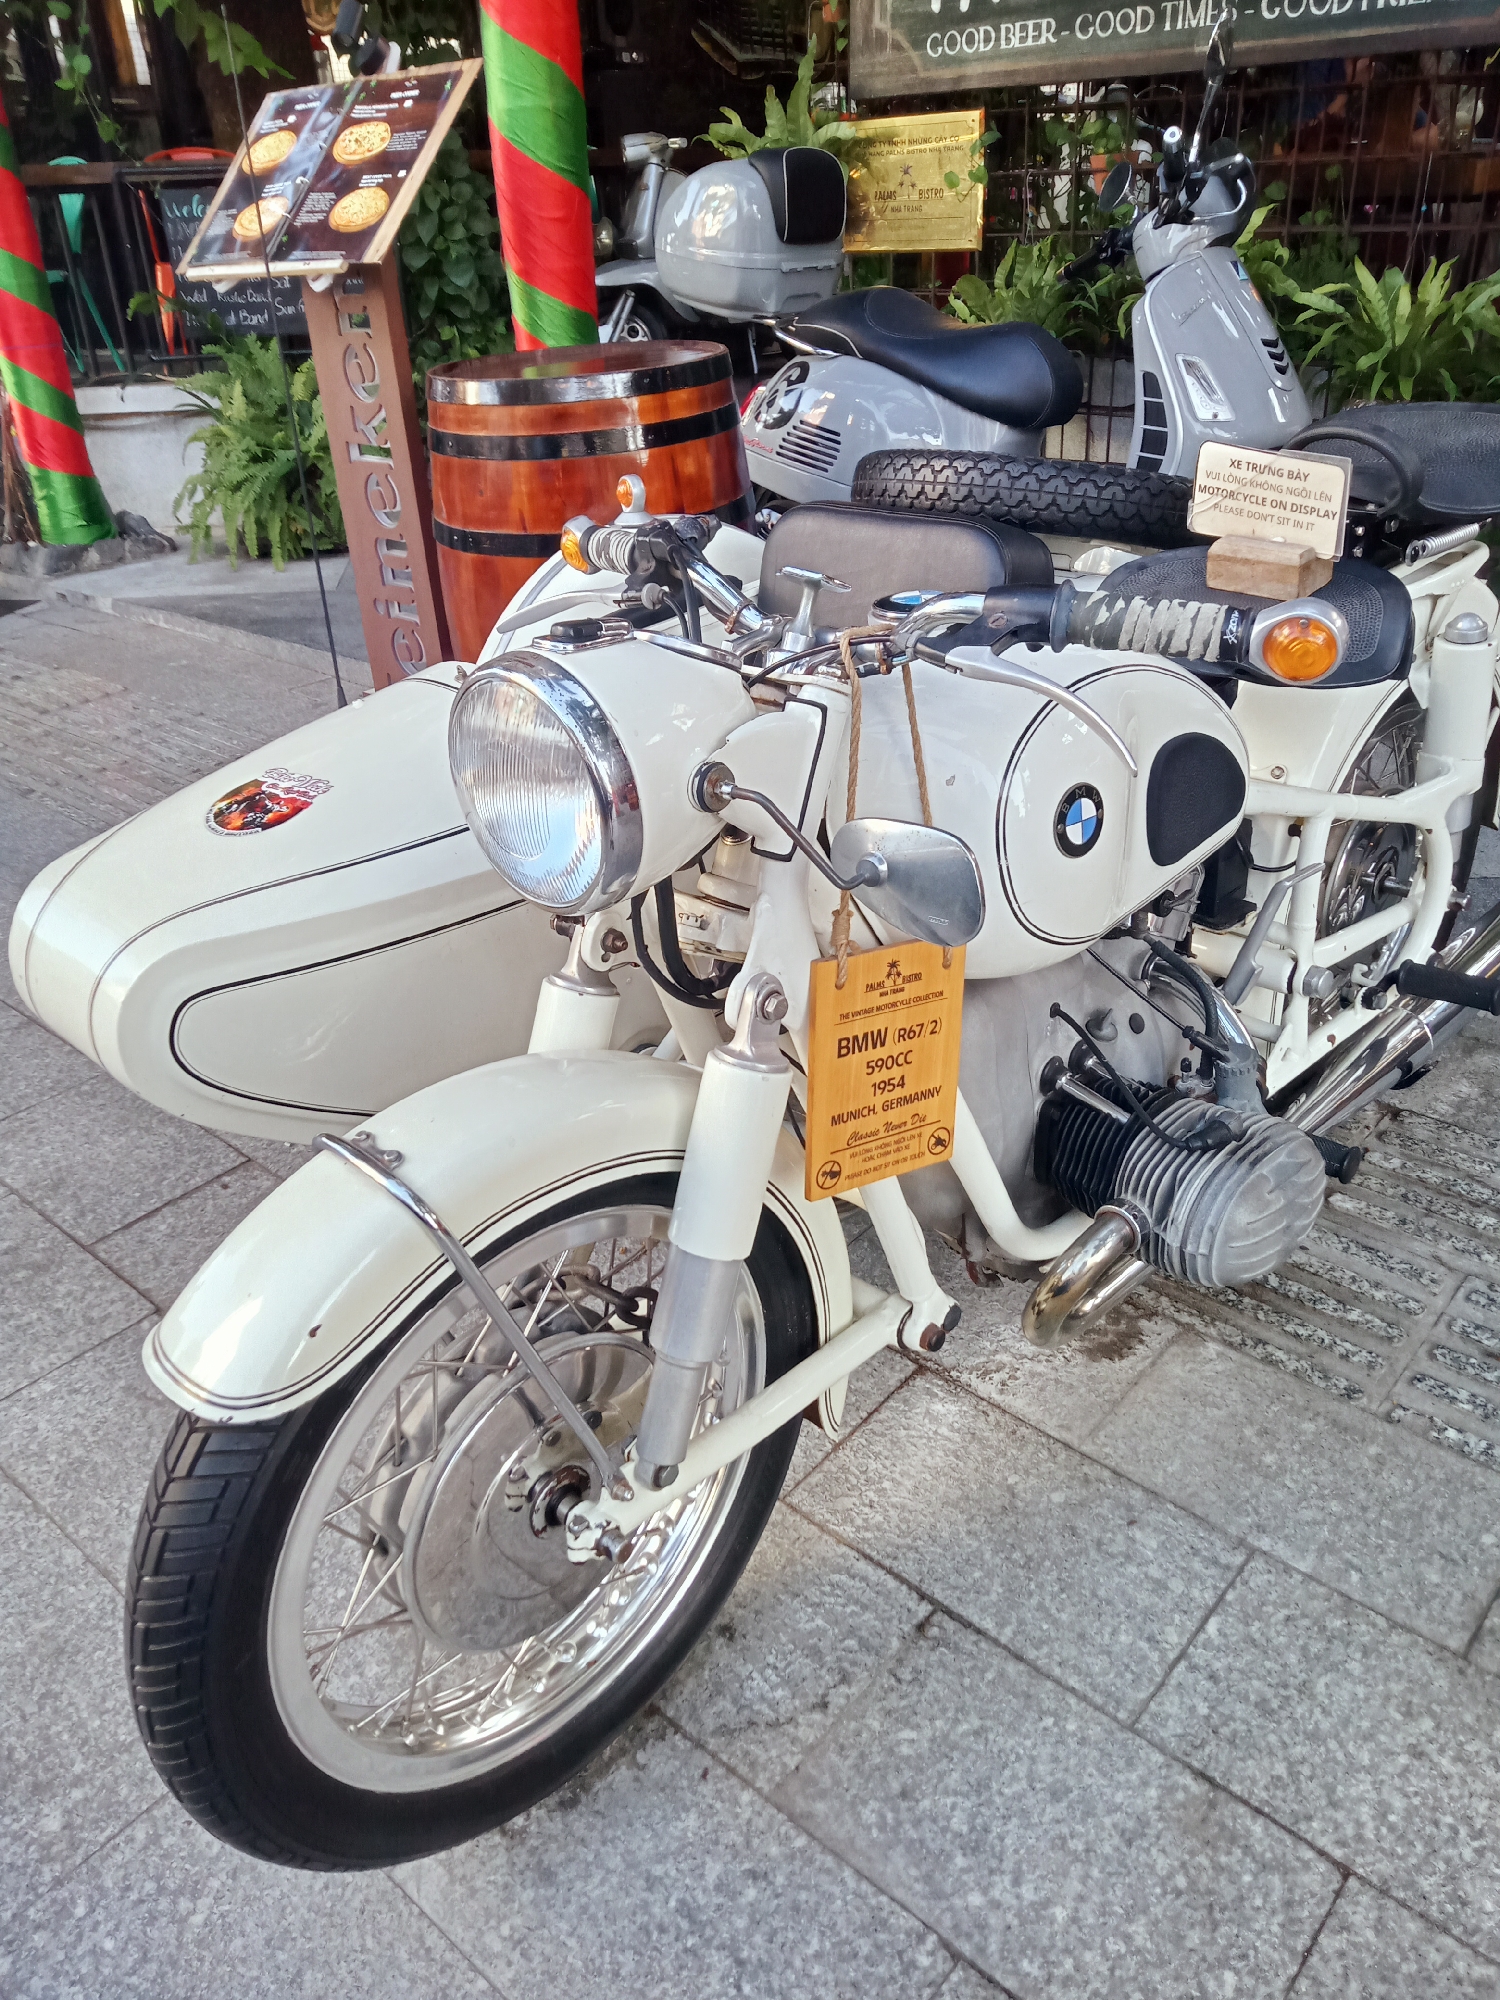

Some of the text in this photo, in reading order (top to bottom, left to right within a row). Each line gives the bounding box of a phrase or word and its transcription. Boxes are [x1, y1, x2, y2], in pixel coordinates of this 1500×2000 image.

[927, 26, 995, 57] GOOD
[1000, 18, 1057, 49] BEER
[1075, 6, 1155, 39] GOOD
[162, 194, 208, 218] Welc
[874, 188, 944, 201] PALMS BISTRO
[890, 204, 923, 213] NHA TRANG
[335, 275, 428, 683] eineken
[1229, 458, 1242, 470] XE
[1287, 468, 1310, 483] BÀY
[1205, 470, 1221, 482] VUI
[1223, 472, 1248, 487] LÒNG
[1250, 480, 1283, 493] KHÔNG
[1314, 489, 1332, 503] LÊN
[1197, 484, 1338, 520] MOTORCYCLE ON DISPLAY
[1213, 504, 1315, 532] PLEASE DON'T SIT IN IT
[1061, 787, 1100, 814] BMW
[865, 972, 923, 992] PALMS BISTRO
[889, 986, 905, 996] TRANG
[839, 990, 944, 1021] THE VINTAGE MOTORCYCLE COLLECTION
[836, 1016, 943, 1059] BMW (R67/2)
[865, 1050, 913, 1076] 590CC
[871, 1075, 906, 1097] 1954
[881, 1085, 942, 1113] GERMANNY
[847, 1113, 927, 1147] Classic Never Die
[845, 1171, 863, 1181] PLEASE
[864, 1167, 872, 1176] DO
[873, 1164, 883, 1173] NOT
[891, 1158, 900, 1166] ON
[900, 1156, 908, 1164] OR
